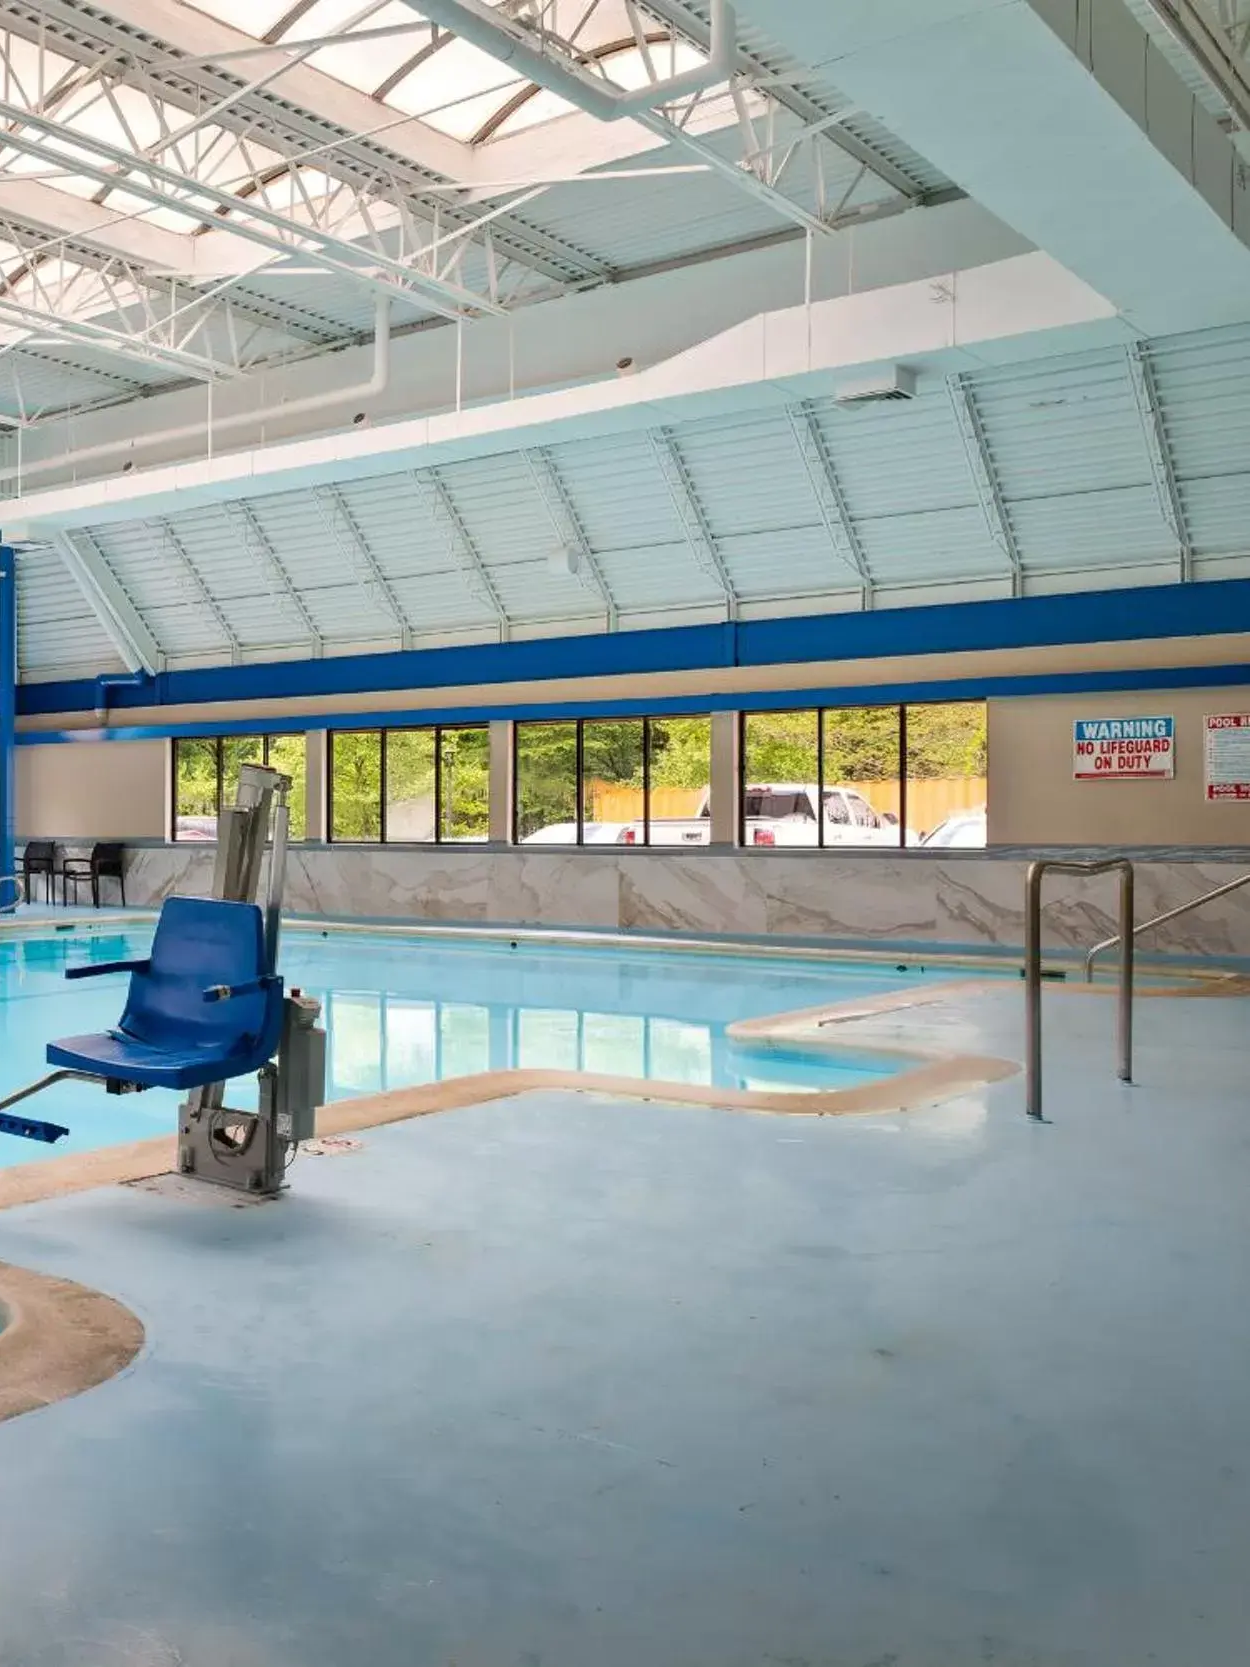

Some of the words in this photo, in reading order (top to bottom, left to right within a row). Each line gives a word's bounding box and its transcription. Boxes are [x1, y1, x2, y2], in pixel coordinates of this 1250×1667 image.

[1082, 720, 1167, 739] WARNING
[1209, 718, 1237, 728] POOL
[1077, 741, 1094, 755] NO
[1100, 739, 1170, 754] LIFEGUARD
[1094, 756, 1112, 770] ON
[1117, 755, 1151, 769] DUTY
